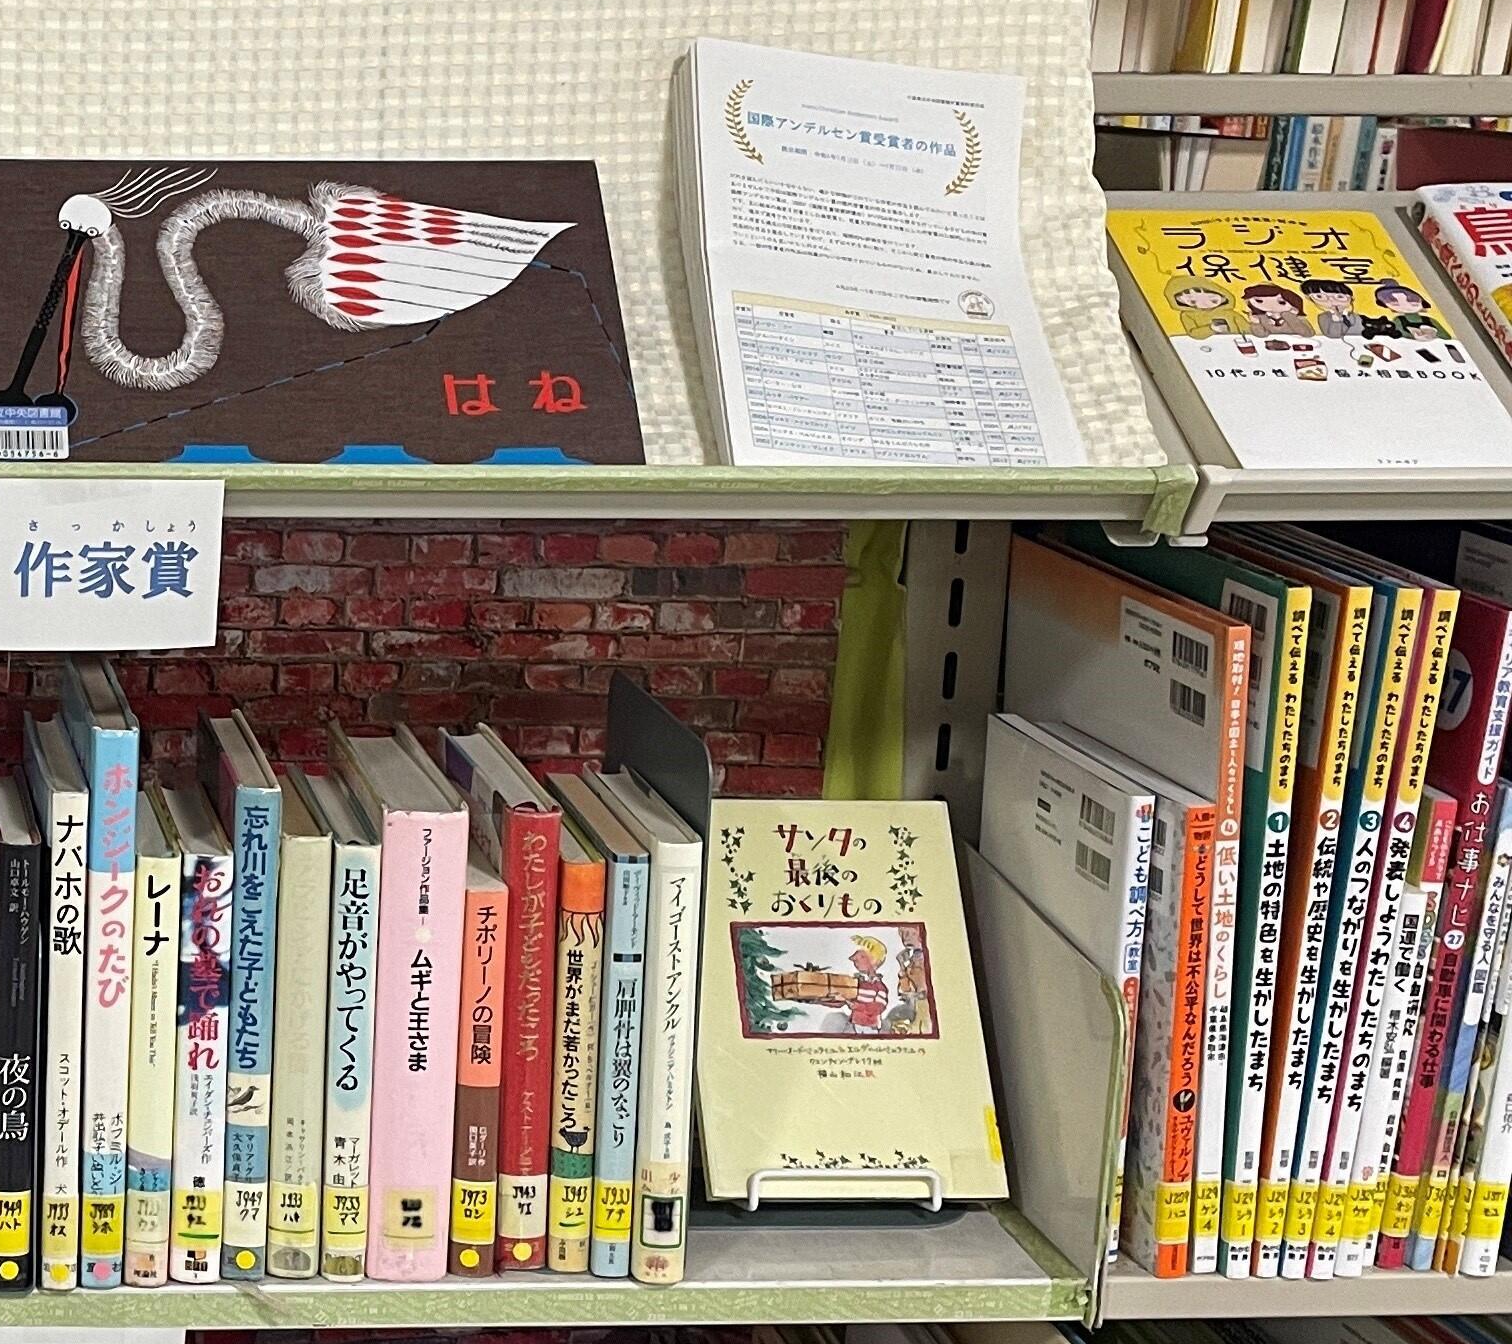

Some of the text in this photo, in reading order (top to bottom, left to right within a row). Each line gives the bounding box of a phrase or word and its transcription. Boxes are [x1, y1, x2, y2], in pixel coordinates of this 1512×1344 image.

[747, 110, 957, 157] 国際アンデルセン賞受賞者の作品
[1161, 223, 1350, 251] ラジオ
[1177, 254, 1386, 286] 保健室
[443, 370, 587, 416] はね
[1205, 367, 1289, 379] 10代の性
[14, 541, 199, 599] 作家賞
[1278, 609, 1306, 789] 調べて伝える わたしたちのまち
[1333, 607, 1367, 787] 調べて伝える わたしたちのまち
[1372, 608, 1414, 789] 調べて伝える わたしたちのまち
[1408, 609, 1453, 790] 調べて伝える わたしたちのまち
[53, 814, 84, 955] ナバホの歌
[143, 875, 171, 956] レーナ
[770, 891, 883, 917] おくりもの
[772, 824, 867, 856] サンタの
[785, 858, 858, 887] 最後の
[187, 863, 226, 1071] おれの墓で踊れ
[236, 805, 270, 1070] 忘れ川をこえた子どもたち
[336, 867, 371, 1091] 足音がやってくる
[470, 905, 498, 1065] チポリーノの冒険
[663, 877, 687, 1029] マイゴーストアンクル
[1179, 844, 1210, 1087] どうして世界は不公平なんだろう
[1212, 844, 1241, 999] 低い土地のくらし
[1246, 839, 1287, 1092] 土地の特色を生かしたまち
[1287, 836, 1337, 1090] 伝統や歴史を生かしたまち
[1316, 837, 1376, 1104] 人のつながりを生かしたまち
[1346, 837, 1411, 1112] 発表しようわたしたちのまち
[1393, 914, 1419, 993] 国連で働く
[1419, 792, 1490, 1090] お仕事ナビ 自動車に関わる仕事
[407, 949, 433, 1073] ムギと王さま
[559, 949, 584, 1129] 世界がまだ若かったころ
[610, 978, 637, 1149] 肩胛骨は翼のなごり
[55, 1053, 70, 1168] スコット・オデール作
